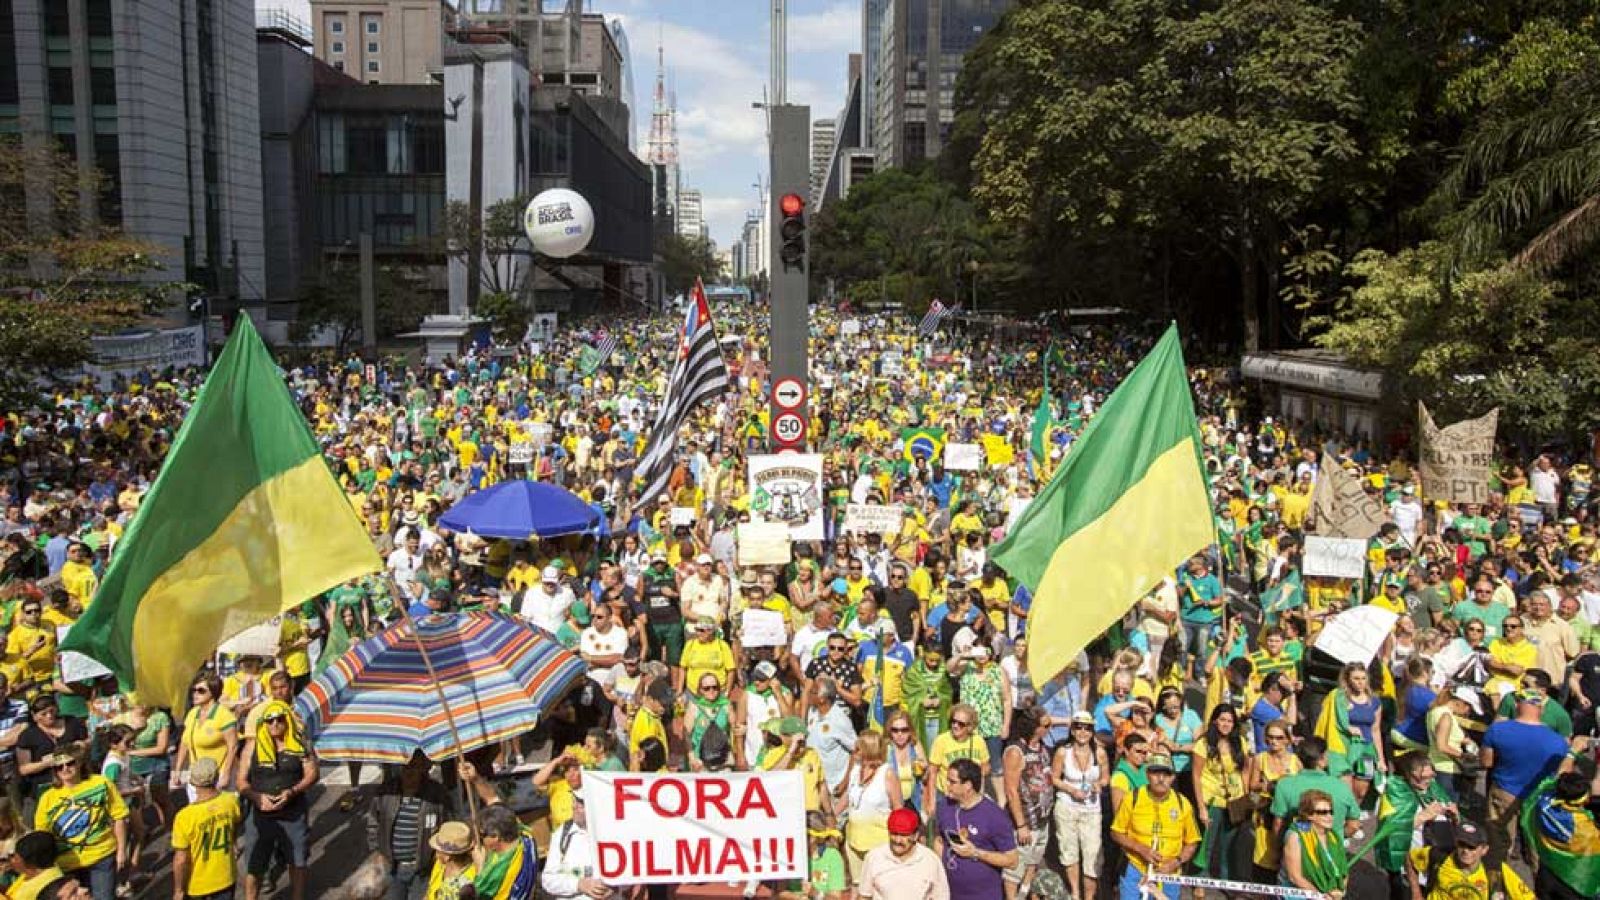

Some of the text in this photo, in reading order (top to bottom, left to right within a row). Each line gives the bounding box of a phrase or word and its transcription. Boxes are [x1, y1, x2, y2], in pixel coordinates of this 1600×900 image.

[538, 212, 574, 225] BRASIL
[779, 419, 799, 433] 50
[613, 777, 777, 820] FORA
[202, 824, 230, 862] 14
[597, 837, 795, 879] DILMA!!!
[1155, 875, 1181, 883] FORA
[1184, 878, 1216, 886] DILMA
[1242, 884, 1270, 893] FORA
[1273, 888, 1306, 896] DILMA
